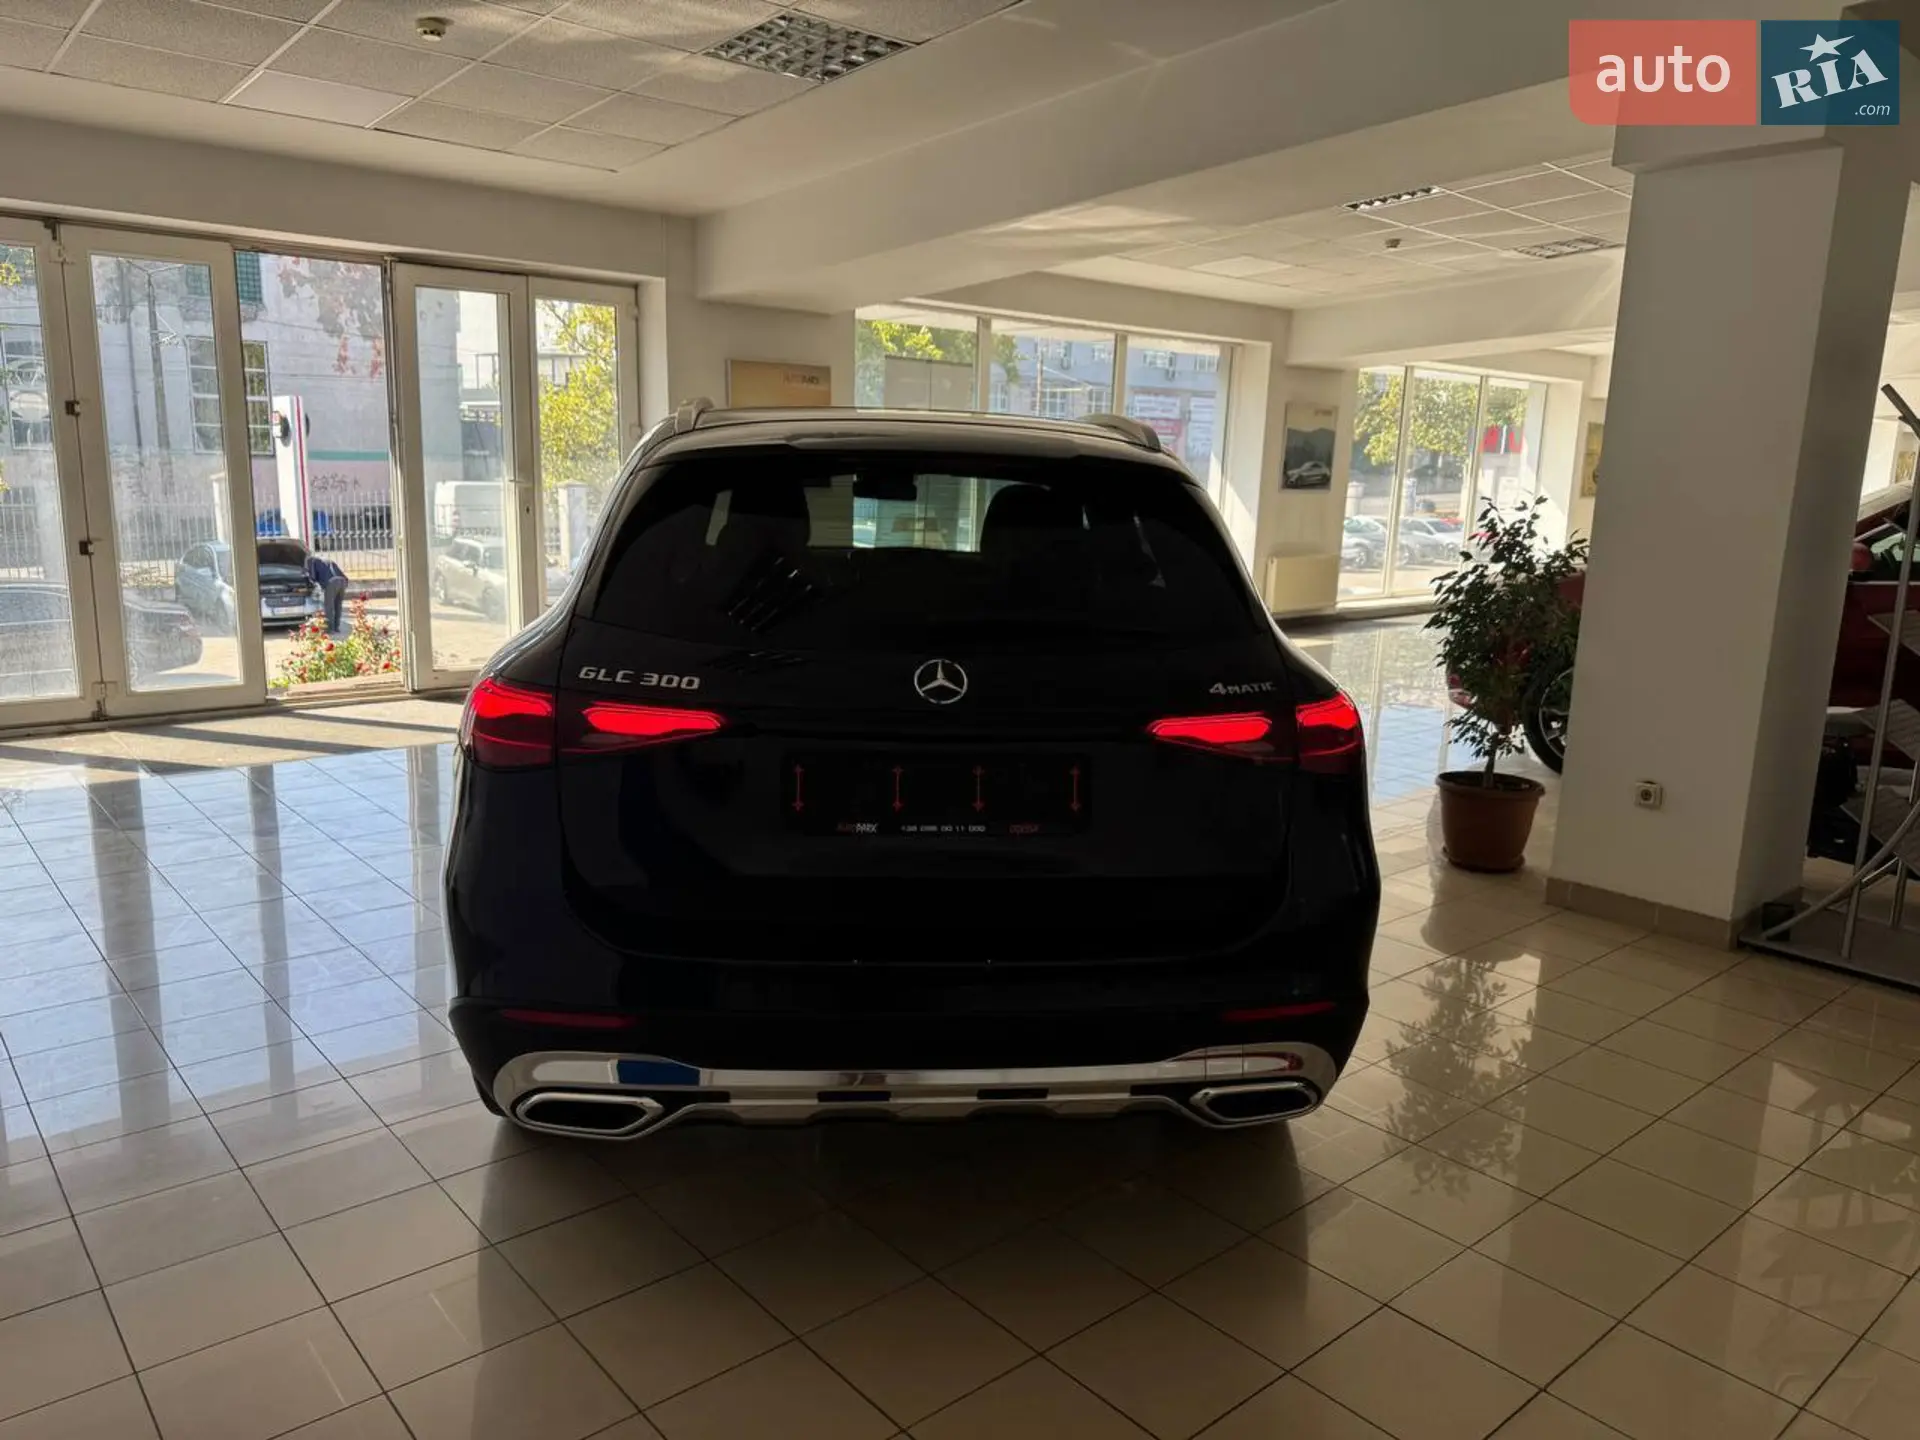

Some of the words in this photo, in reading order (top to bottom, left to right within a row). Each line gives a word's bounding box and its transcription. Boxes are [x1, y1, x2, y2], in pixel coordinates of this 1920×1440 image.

[578, 666, 635, 684] GLC
[640, 672, 701, 690] 300
[1208, 681, 1278, 696] 4MATIC
